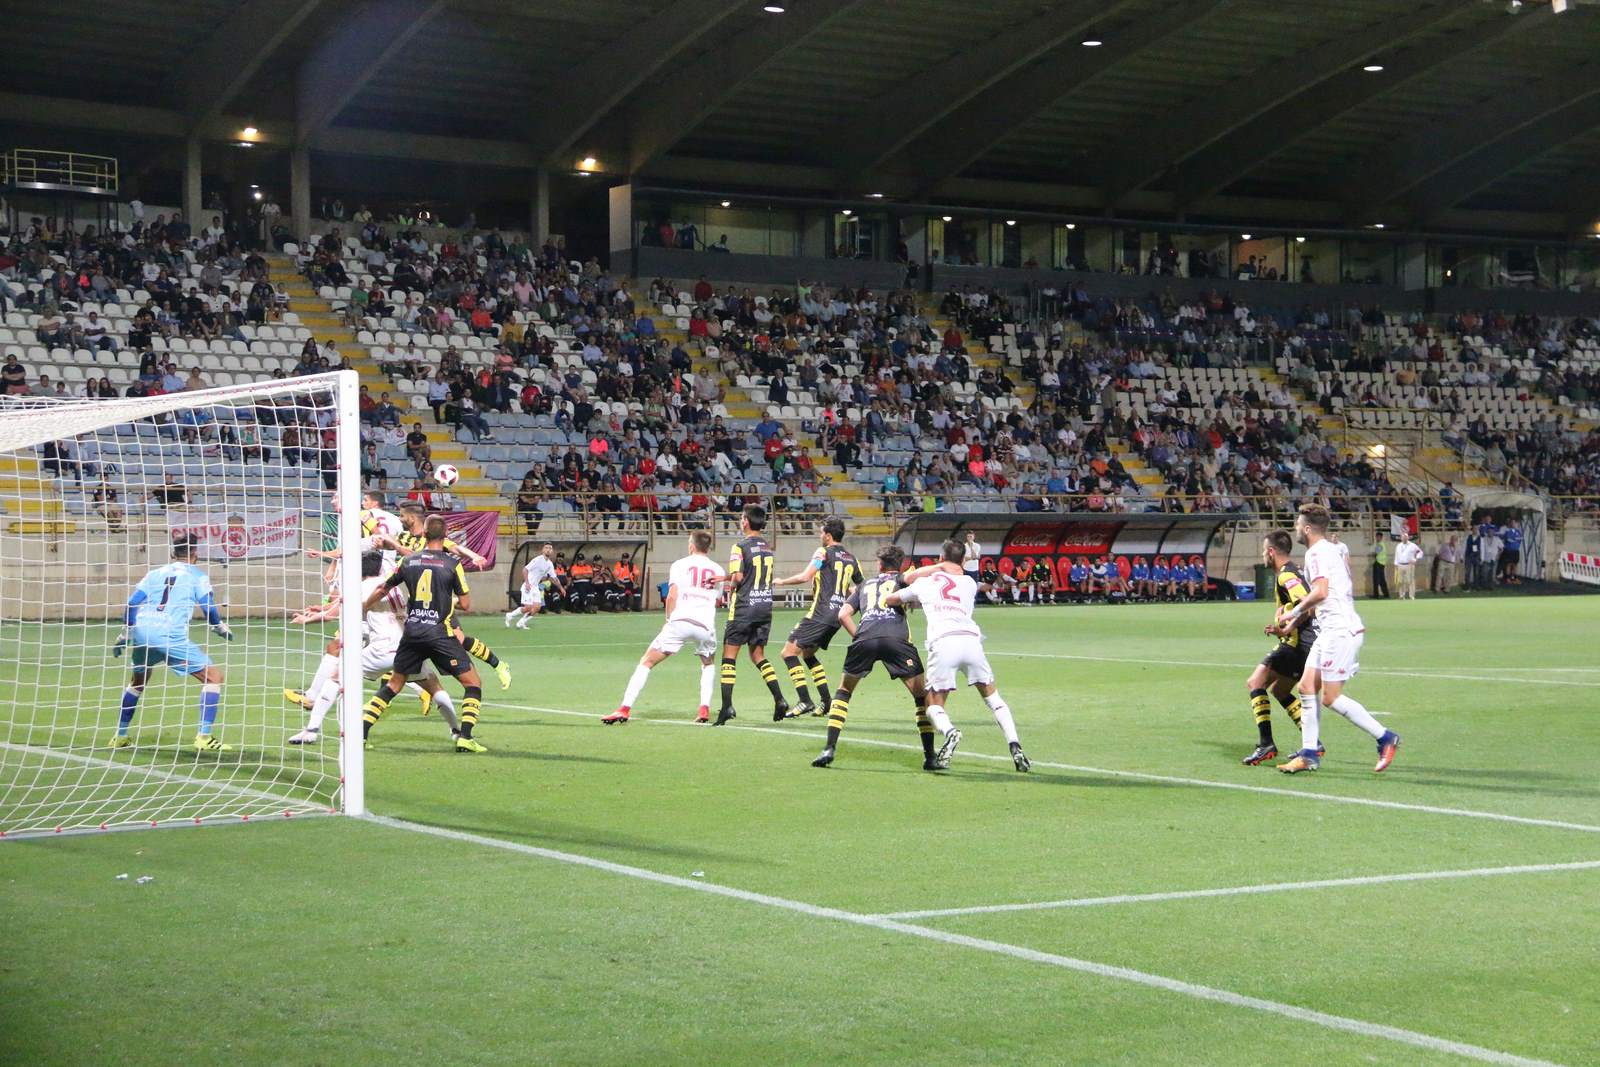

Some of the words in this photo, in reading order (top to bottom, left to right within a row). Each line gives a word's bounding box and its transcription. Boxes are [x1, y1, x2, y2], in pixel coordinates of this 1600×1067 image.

[251, 514, 298, 536] SIEMPRE
[752, 555, 774, 590] 11
[415, 568, 433, 609] 4
[933, 573, 961, 604] 2
[409, 608, 440, 619] ABANCA
